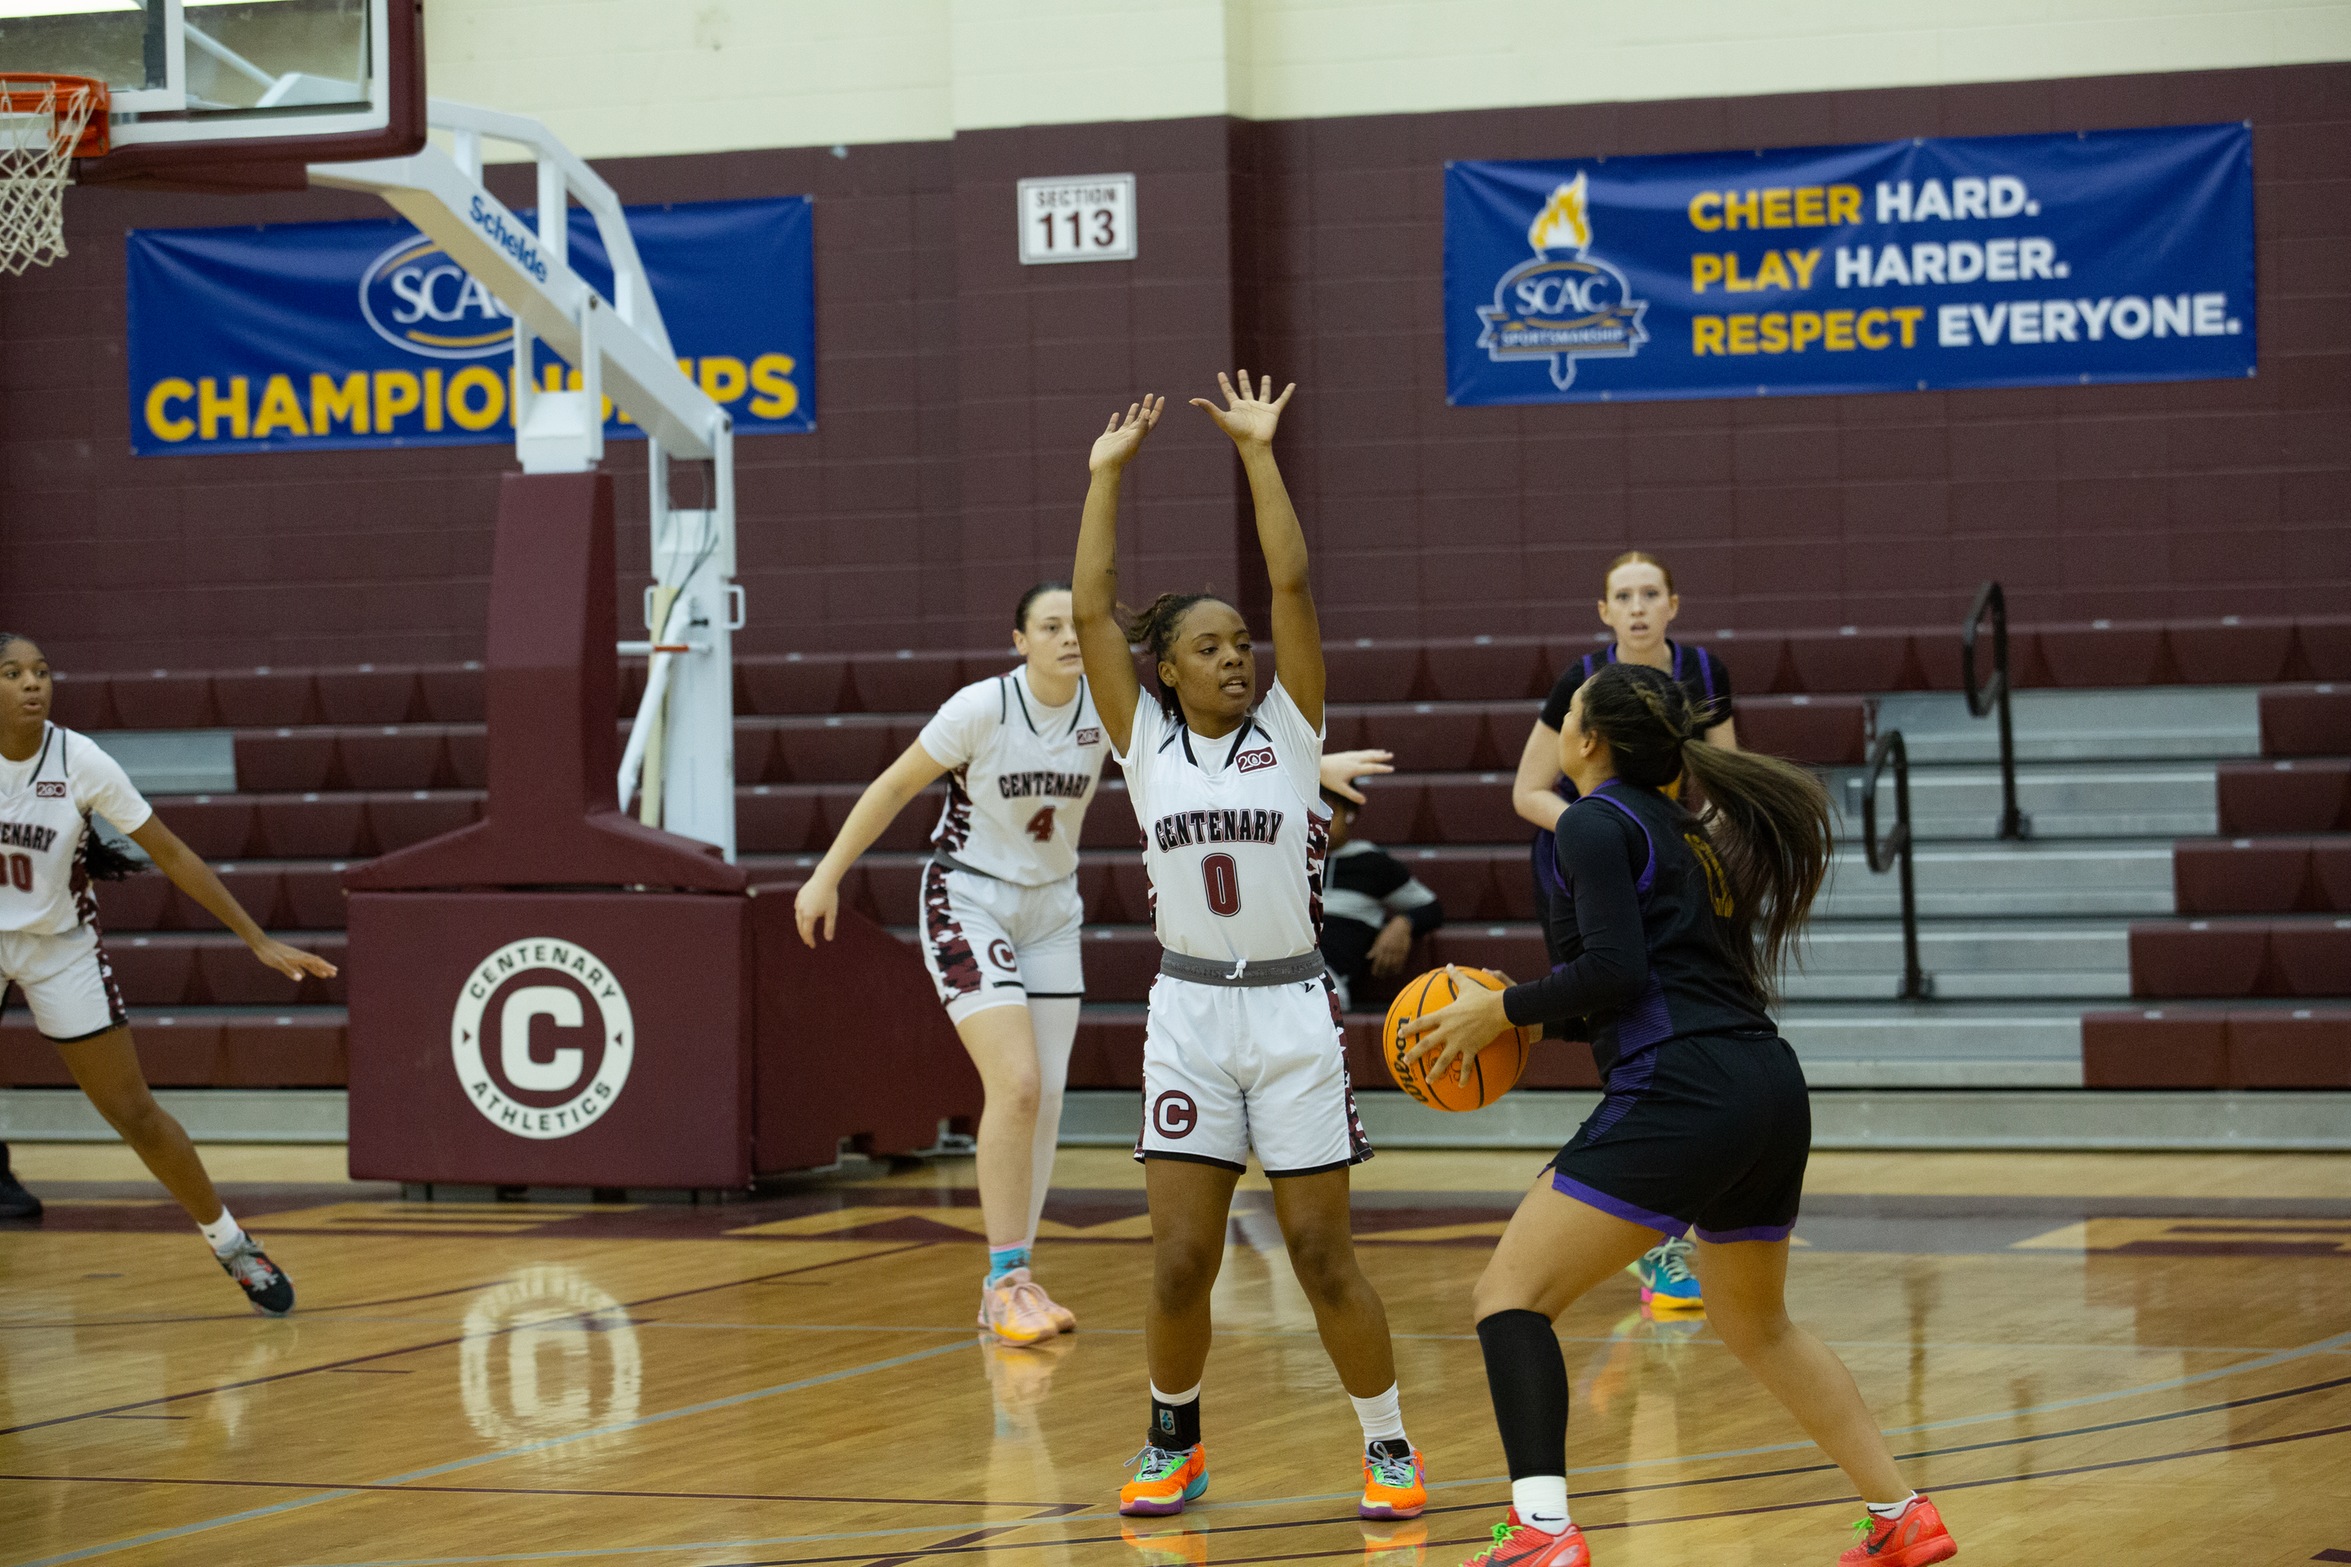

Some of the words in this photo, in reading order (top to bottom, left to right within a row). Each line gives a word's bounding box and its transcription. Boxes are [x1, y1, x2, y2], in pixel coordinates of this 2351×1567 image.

[1035, 187, 1116, 208] SECTION
[1688, 184, 1862, 232] CHEER
[1876, 176, 2041, 223] HARD.
[469, 195, 548, 284] Schelde
[1038, 208, 1116, 250] 113
[1691, 248, 1821, 294] PLAY
[1834, 237, 2069, 289] HARDER.
[1515, 275, 1609, 316] SCAC
[1692, 306, 1926, 356] RESPECT
[1938, 292, 2242, 348] EVERYONE.
[1238, 751, 1273, 771] 200
[997, 771, 1091, 802] CENTENARY
[0, 821, 58, 853] ENARY
[1025, 805, 1055, 843] 4
[1154, 809, 1285, 853] CENTENARY
[1201, 852, 1241, 918] 0
[470, 944, 618, 1002] CENTENARY
[501, 986, 584, 1092] C
[472, 1081, 612, 1132] ATHLETICS
